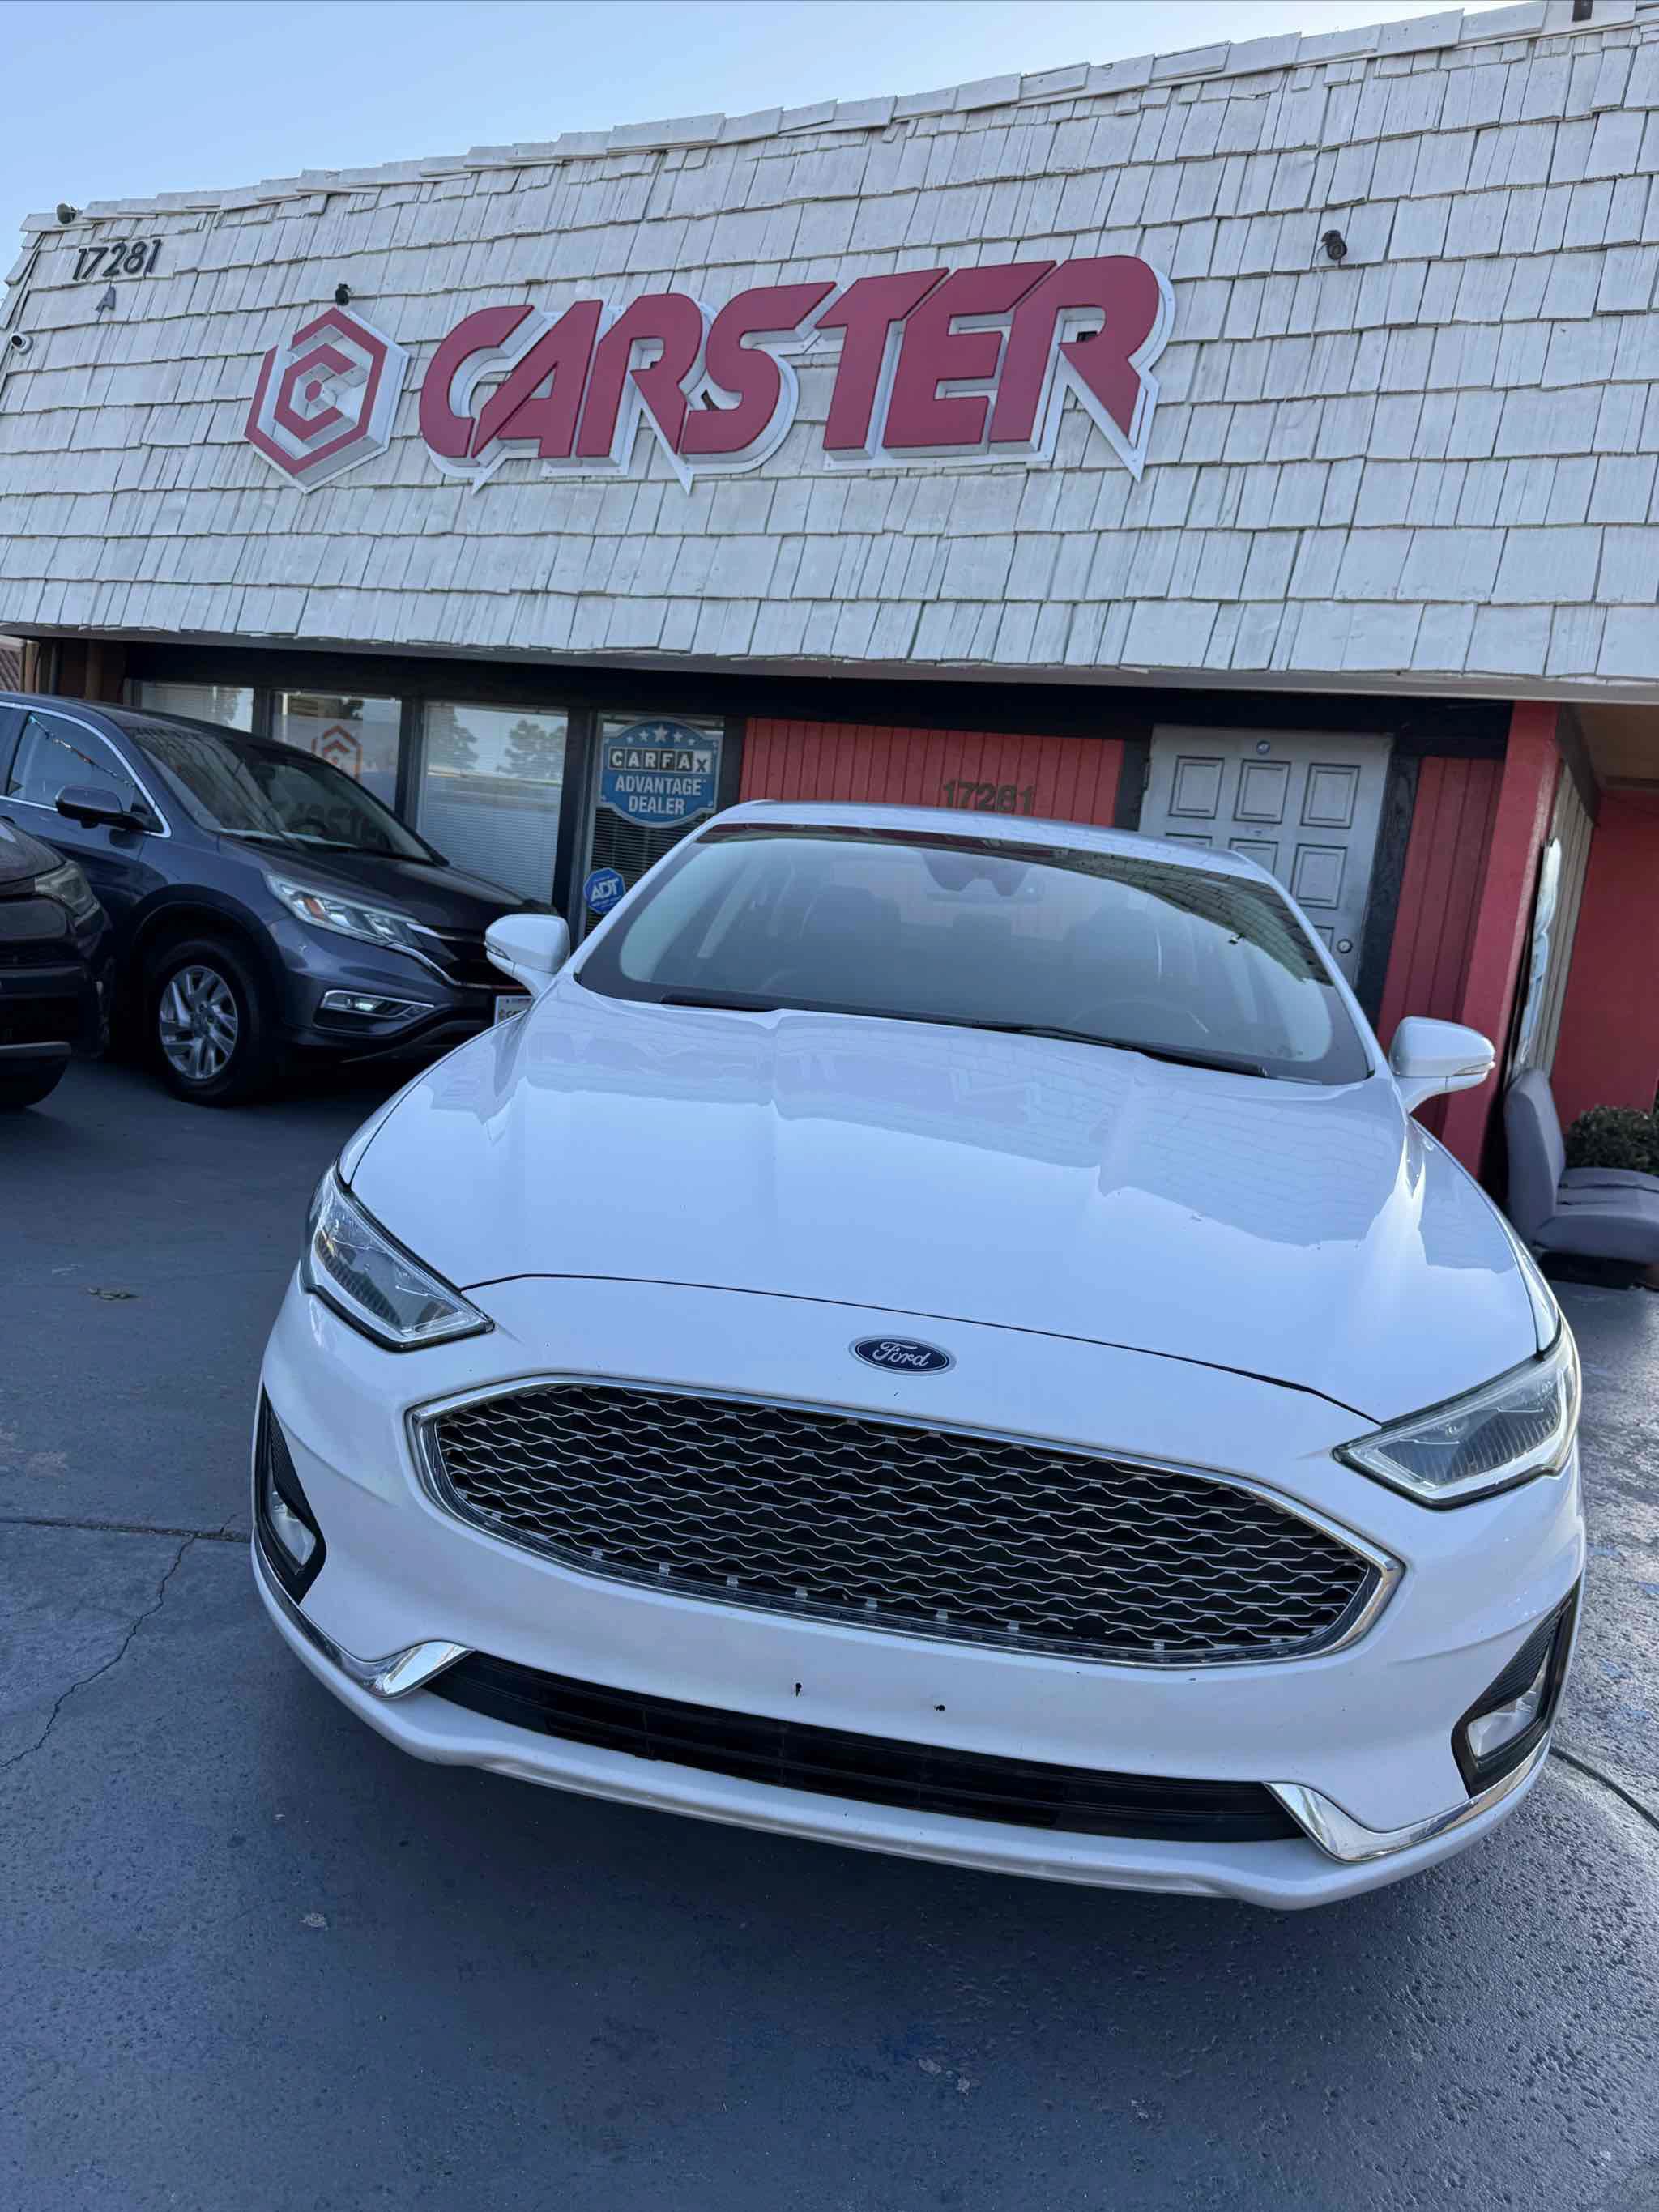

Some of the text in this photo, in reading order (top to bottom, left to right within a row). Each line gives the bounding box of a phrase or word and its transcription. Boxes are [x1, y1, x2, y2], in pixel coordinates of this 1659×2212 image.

[73, 239, 161, 281] 17281
[95, 283, 117, 313] A
[419, 254, 1162, 462] CARSTER
[610, 749, 711, 773] CARFAX
[615, 775, 702, 796] ADVANTAGE
[944, 779, 1035, 816] 17281
[628, 795, 686, 815] DEALER
[591, 877, 620, 902] ADT
[872, 1341, 932, 1367] Ford
